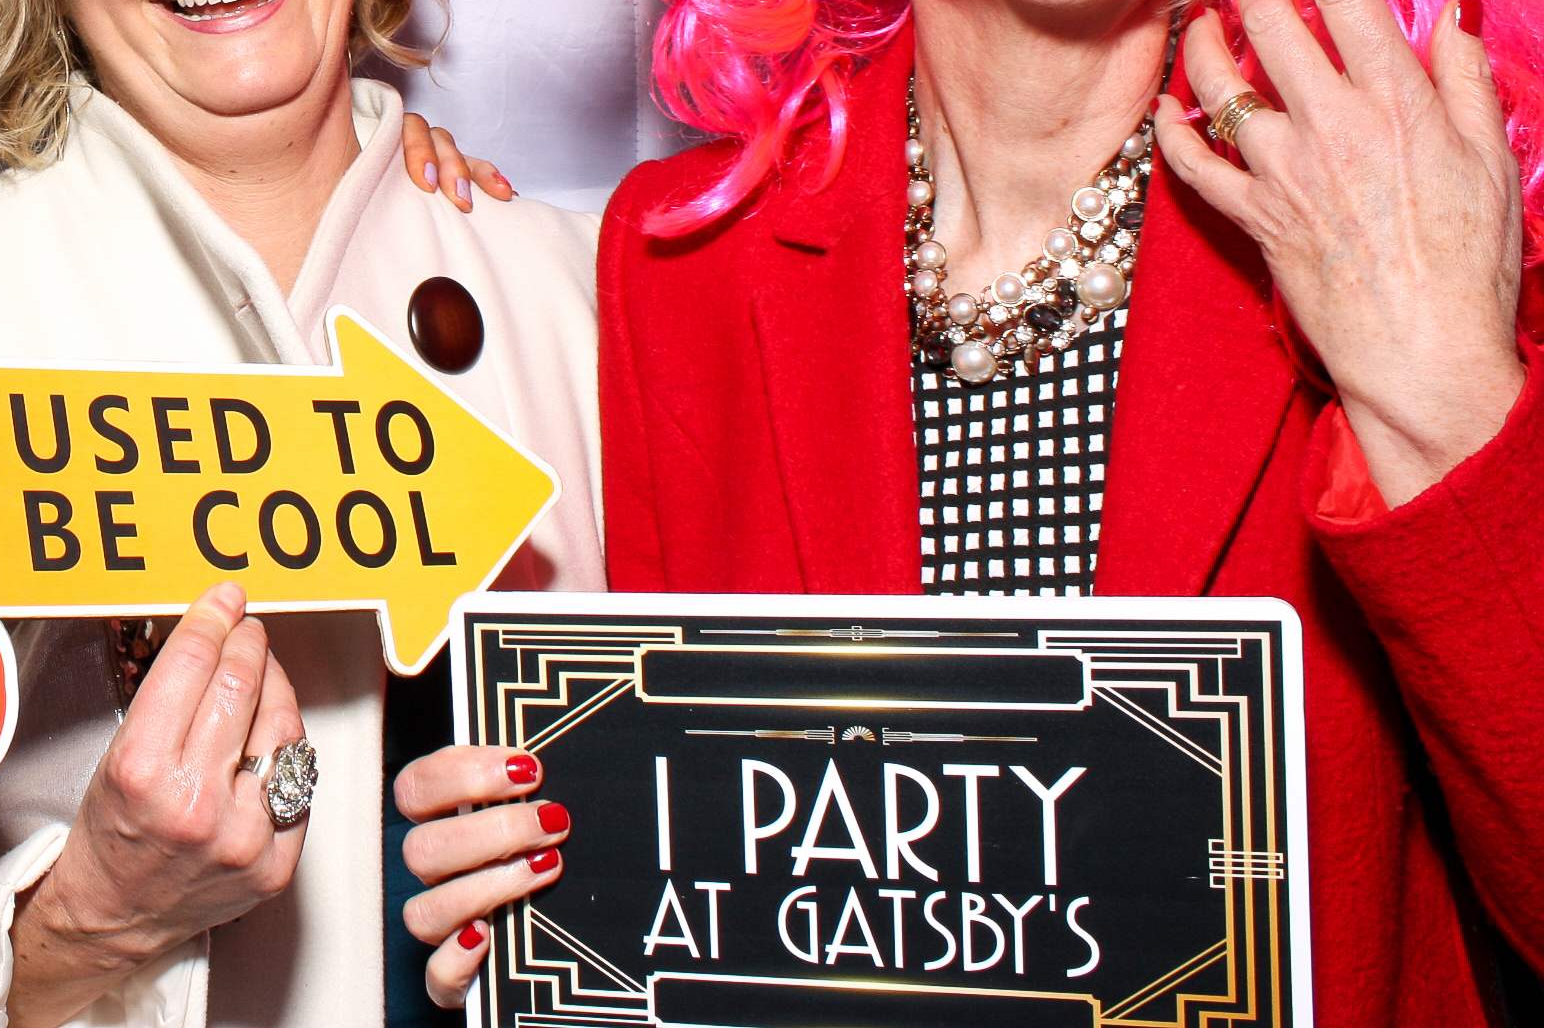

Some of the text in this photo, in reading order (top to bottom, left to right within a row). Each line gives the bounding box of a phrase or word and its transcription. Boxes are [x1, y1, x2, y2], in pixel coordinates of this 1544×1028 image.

[9, 393, 436, 475] USED TO
[22, 489, 457, 572] BE COOL
[654, 755, 1087, 886] I PARTY
[642, 877, 1101, 978] AT GATSBY'S
